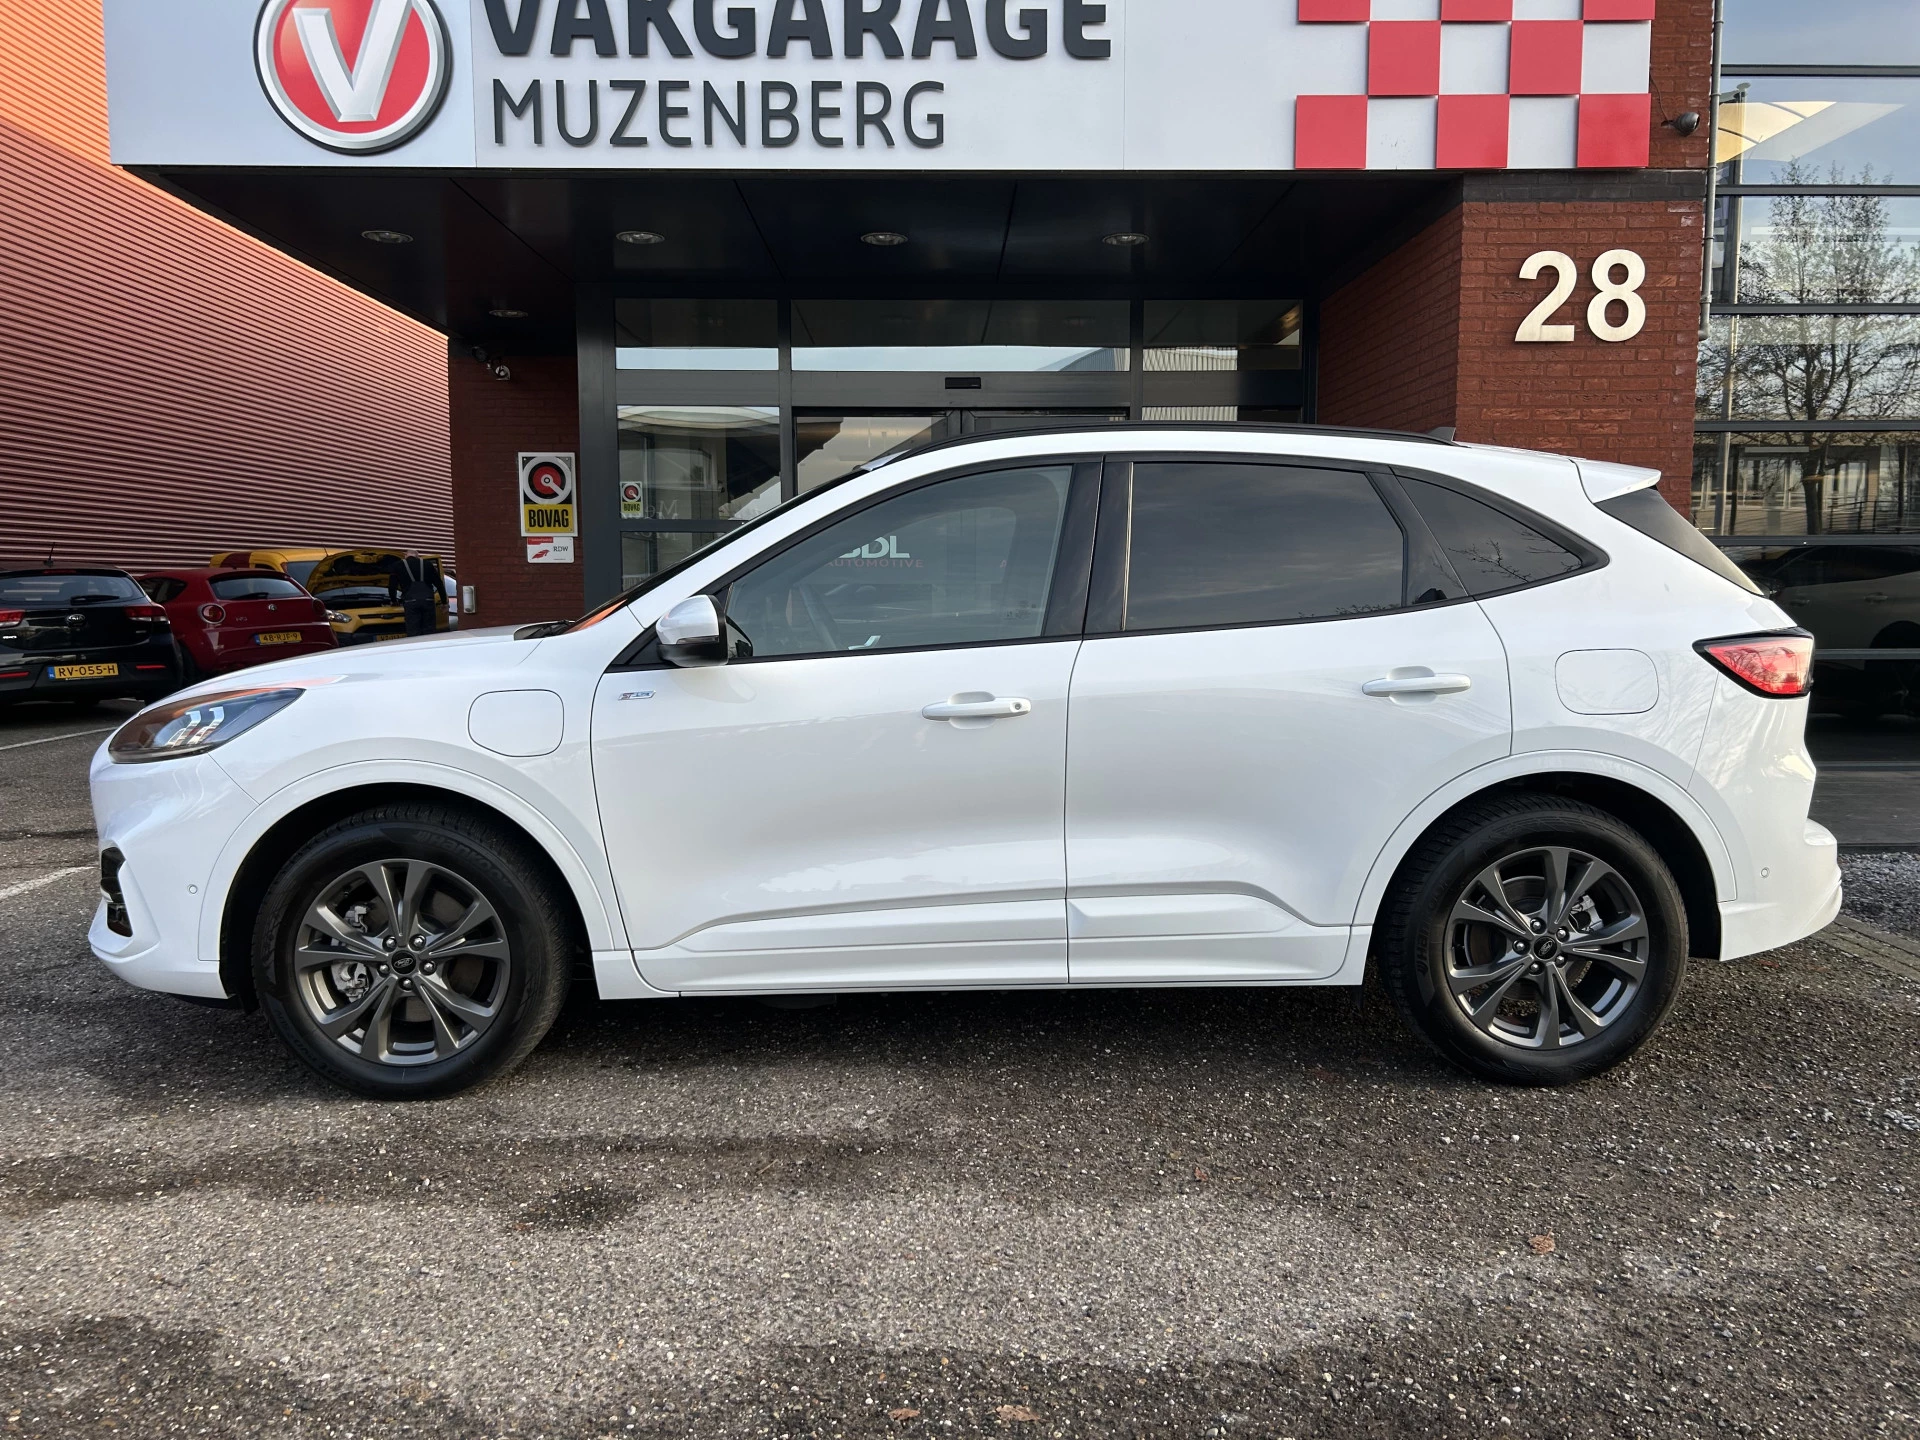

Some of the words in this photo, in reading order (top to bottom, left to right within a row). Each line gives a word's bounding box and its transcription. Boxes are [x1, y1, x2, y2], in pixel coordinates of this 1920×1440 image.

[485, 0, 1111, 59] VAKGARAGE
[493, 78, 945, 149] MUZENBERG
[1514, 248, 1646, 342] 28
[528, 508, 570, 528] BOVAG
[623, 503, 641, 512] BOVAG
[58, 664, 116, 677] RV-055-H
